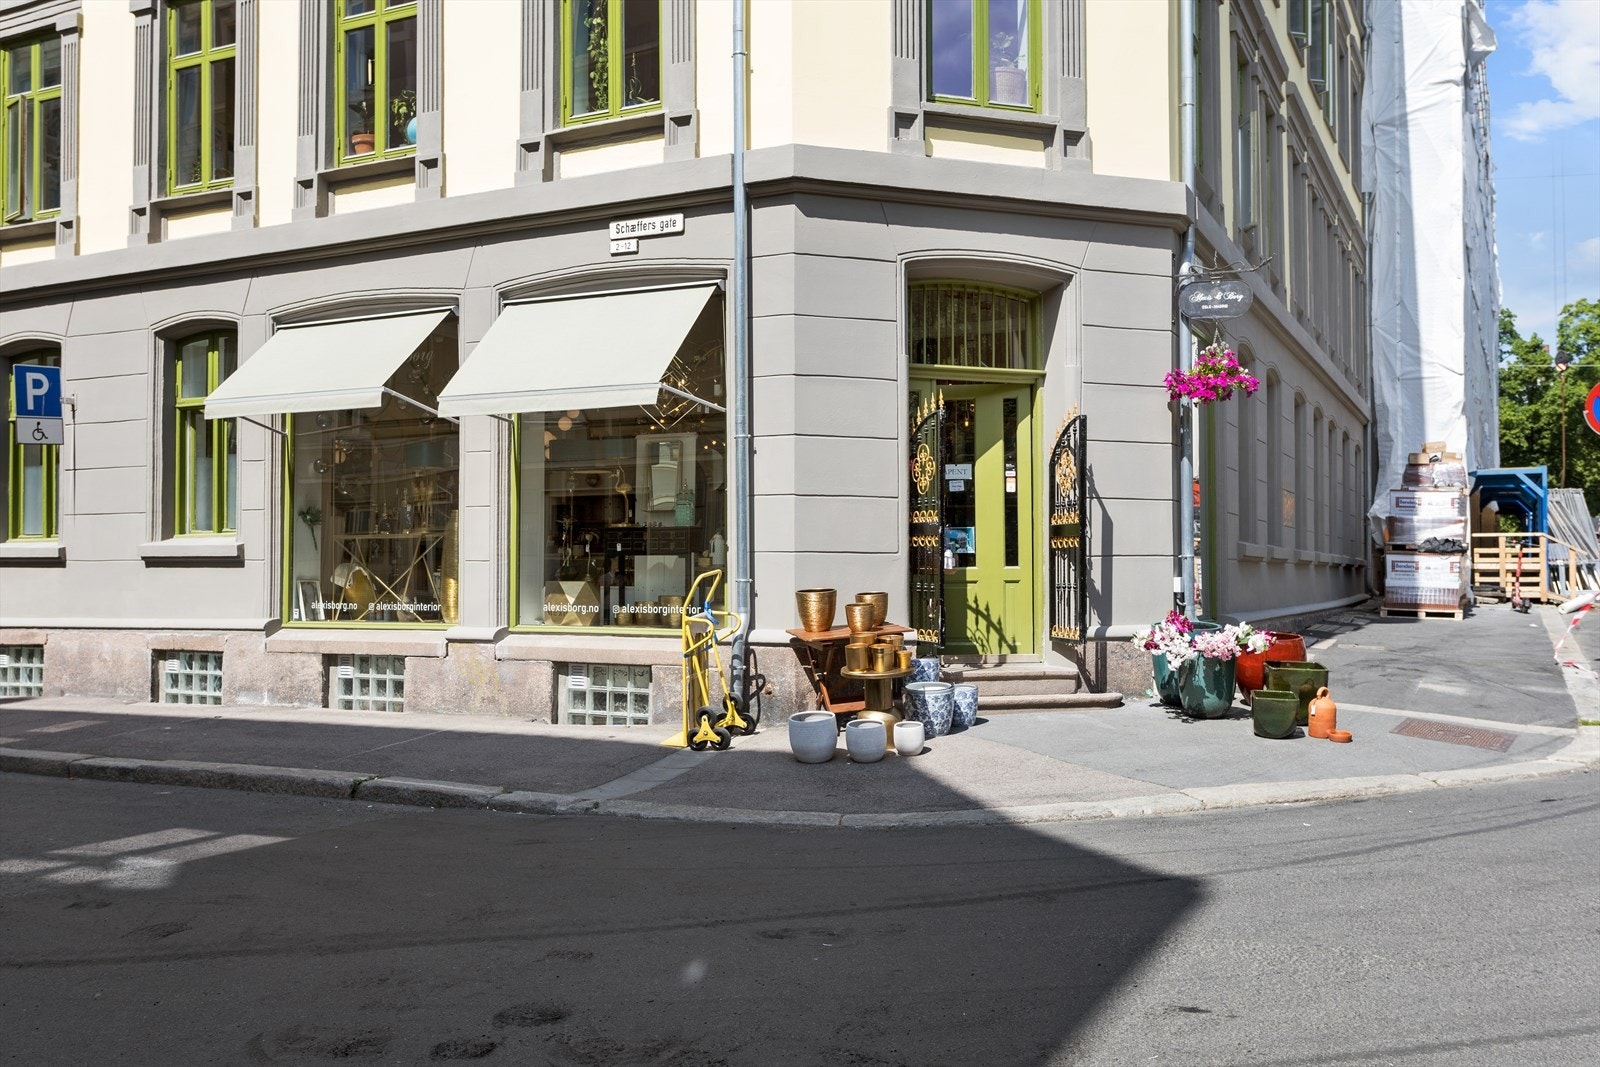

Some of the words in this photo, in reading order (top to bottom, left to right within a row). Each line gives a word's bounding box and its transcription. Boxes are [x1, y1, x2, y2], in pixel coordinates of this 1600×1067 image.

[615, 220, 656, 234] Schæffers
[659, 218, 677, 232] gate
[615, 242, 631, 251] 2-12
[1223, 291, 1244, 302] Borg
[25, 372, 50, 411] P
[311, 601, 358, 612] alexisborg.no
[543, 602, 599, 614] alexisborg.no
